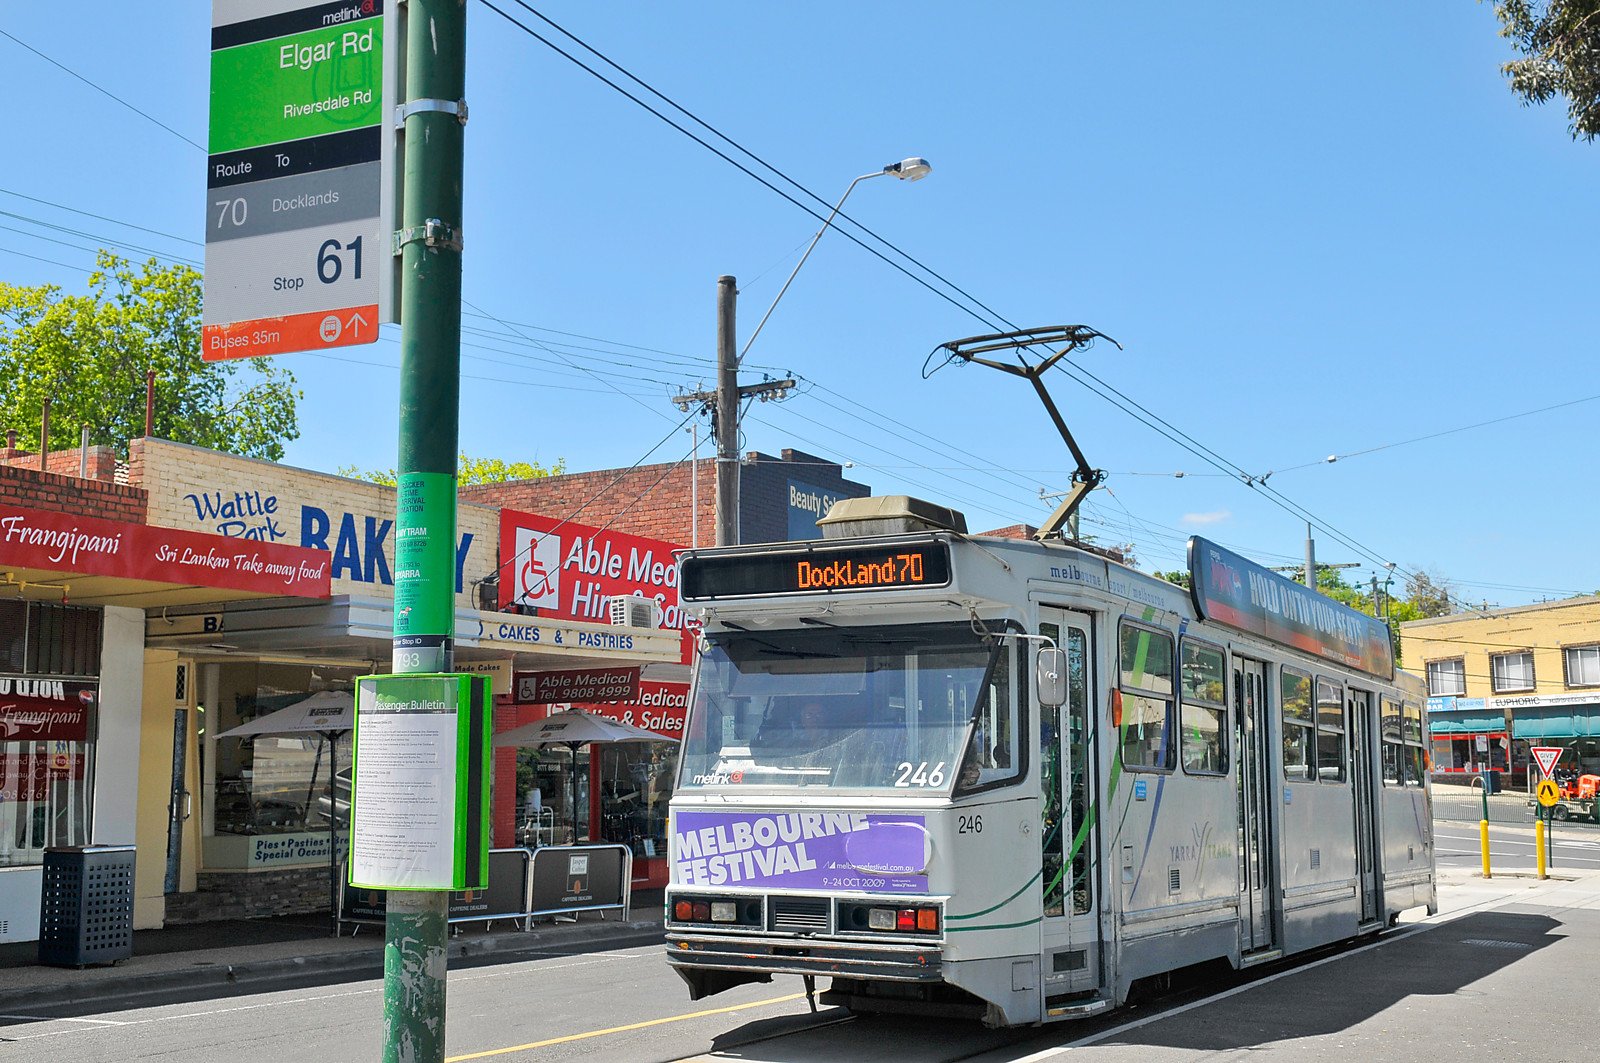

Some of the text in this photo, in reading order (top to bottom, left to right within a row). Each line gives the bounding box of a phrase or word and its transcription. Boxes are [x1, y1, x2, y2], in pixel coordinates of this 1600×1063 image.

[322, 5, 362, 25] metlink
[279, 28, 373, 70] Elgar Rd
[283, 89, 372, 118] Riversdale Rd
[216, 154, 290, 178] Route To
[215, 190, 339, 229] 70 Docklands
[273, 235, 363, 291] Stop 61
[211, 330, 280, 350] Buses 35m
[402, 481, 425, 489] ACKER
[184, 490, 278, 521] Wattle
[790, 485, 821, 518] Beauty
[1, 516, 121, 565] Frangipani
[217, 517, 286, 541] Park
[301, 504, 474, 593] BAKY
[155, 545, 325, 584] Sri Lankan Take away food
[563, 536, 678, 588] Able Med
[897, 553, 923, 582] 70
[1050, 565, 1101, 586] melbourne
[571, 580, 699, 629] Hir Sale
[1248, 570, 1280, 614] HOLD
[1309, 598, 1337, 639] YOUR
[1336, 611, 1364, 648] SEATS
[499, 623, 540, 642] CAKES
[554, 630, 563, 644] &
[579, 632, 633, 649] PASTRIES
[539, 672, 632, 688] Able Medical
[539, 686, 631, 699] Tel. 9808 4999
[376, 699, 446, 712] Passenger Bulletin
[1495, 697, 1540, 707] EUPHORIC
[1, 704, 83, 733] Frangipani
[639, 711, 683, 731] Sales
[693, 772, 730, 785] metlink
[894, 762, 945, 788] 246
[676, 813, 870, 861] MELBOURNE
[958, 815, 983, 835] 246
[254, 848, 294, 862] Special
[297, 847, 341, 858] Occasin
[256, 840, 279, 850] Pies
[287, 838, 324, 848] Pasties
[1170, 846, 1197, 862] YARRA
[677, 842, 817, 886] FESTIVAL
[837, 862, 914, 872] melbornefestival.com.au
[843, 878, 860, 886] OCT
[862, 879, 886, 888] 2009
